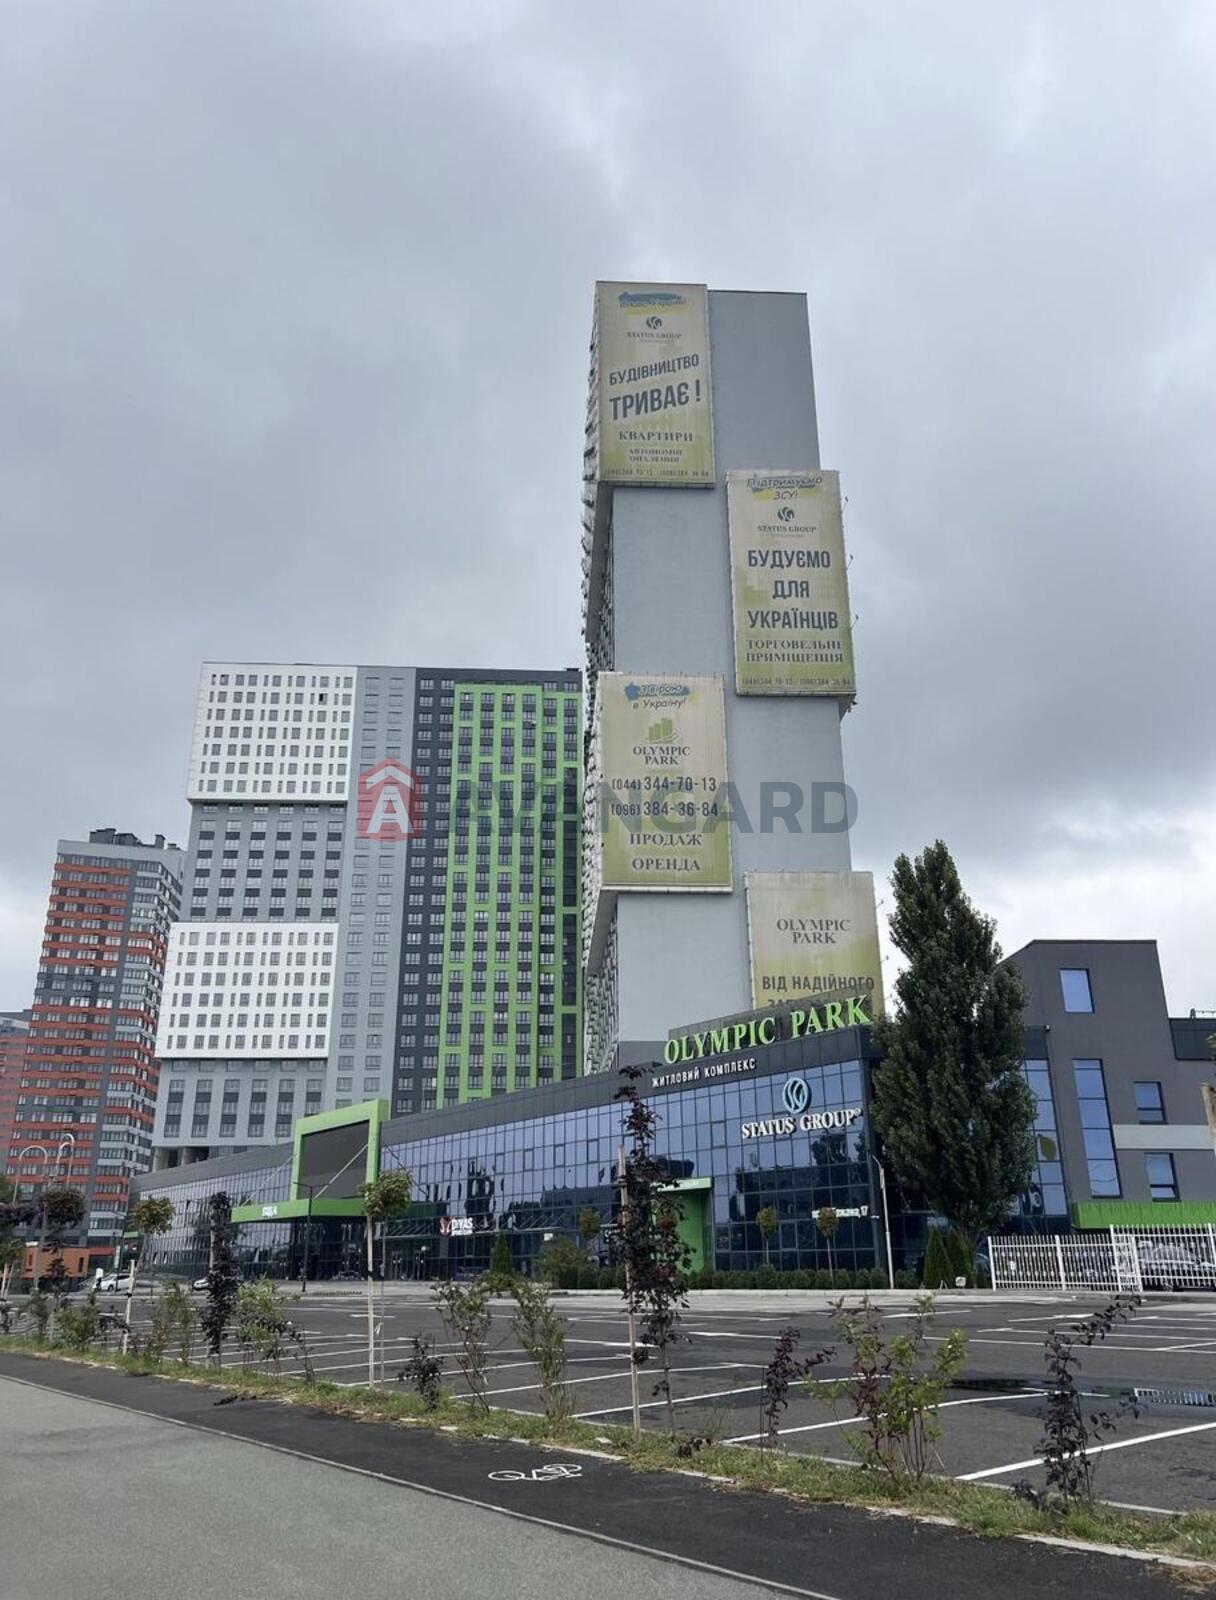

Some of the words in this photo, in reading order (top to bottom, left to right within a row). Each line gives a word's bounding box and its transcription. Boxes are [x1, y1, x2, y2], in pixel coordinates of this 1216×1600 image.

[609, 354, 699, 386] БУДІВНИЦТВО
[619, 431, 693, 441] КВАРТИРИ
[748, 550, 831, 569] БУДУЄМО
[772, 580, 810, 600] ДЛЯ
[748, 608, 839, 630] УКРАЇНЦІВ
[746, 640, 841, 649] ТОРГОВЕЛЬНІ
[746, 653, 843, 663] ПРИМІЩЕННЯ
[633, 746, 690, 756] OLYMPIC
[645, 756, 679, 765] PARK
[629, 833, 703, 846] ПРОДАЖ
[632, 858, 701, 872] ОРЕНДА
[777, 919, 851, 931] OLYMPIC
[793, 932, 836, 944] PARK
[762, 976, 788, 992] ВІД
[792, 973, 875, 992] НАДІЙНОГО
[664, 1017, 777, 1065] OLYMPIC
[790, 994, 873, 1039] PARK
[652, 1066, 700, 1087] ЖИТЛОВИЙ
[704, 1058, 757, 1078] КОМПЛЕКС
[741, 1116, 796, 1139] STATUS
